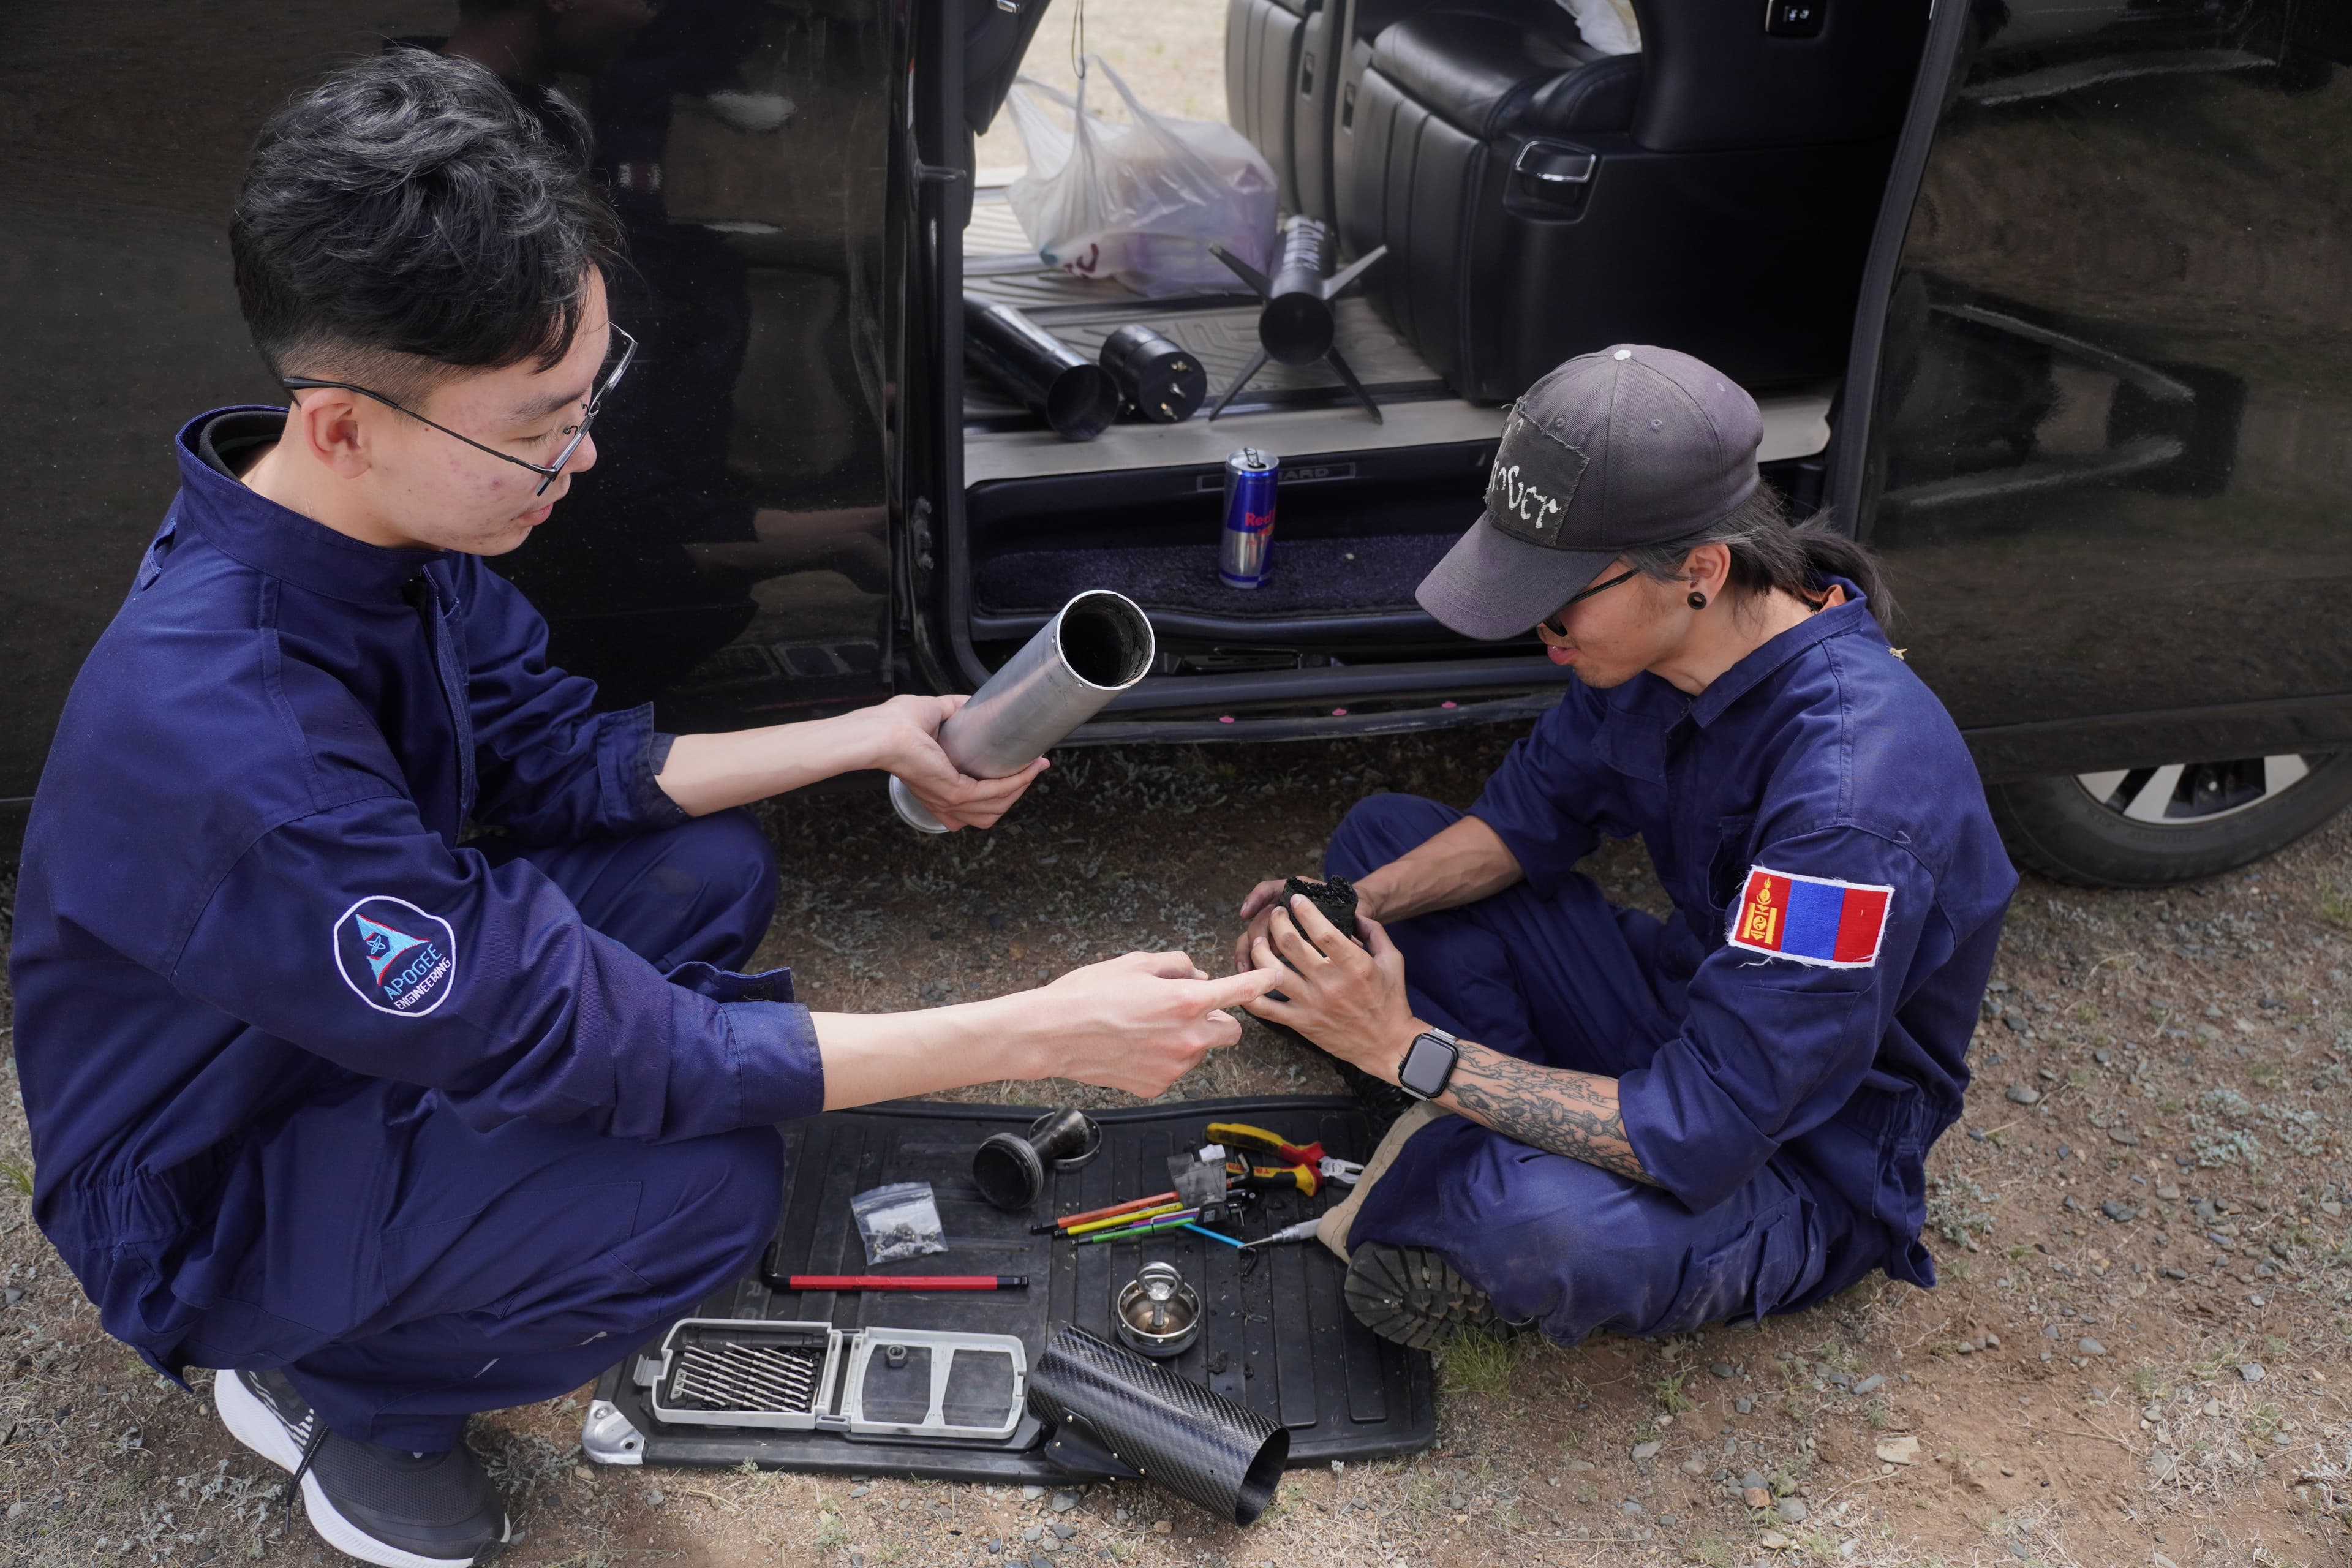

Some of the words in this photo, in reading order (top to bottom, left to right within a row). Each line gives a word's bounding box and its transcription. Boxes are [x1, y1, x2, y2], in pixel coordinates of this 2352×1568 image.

[1245, 510, 1272, 526] Red
[384, 943, 442, 1000] APOGEE
[393, 957, 451, 1009] ENGINEERING
